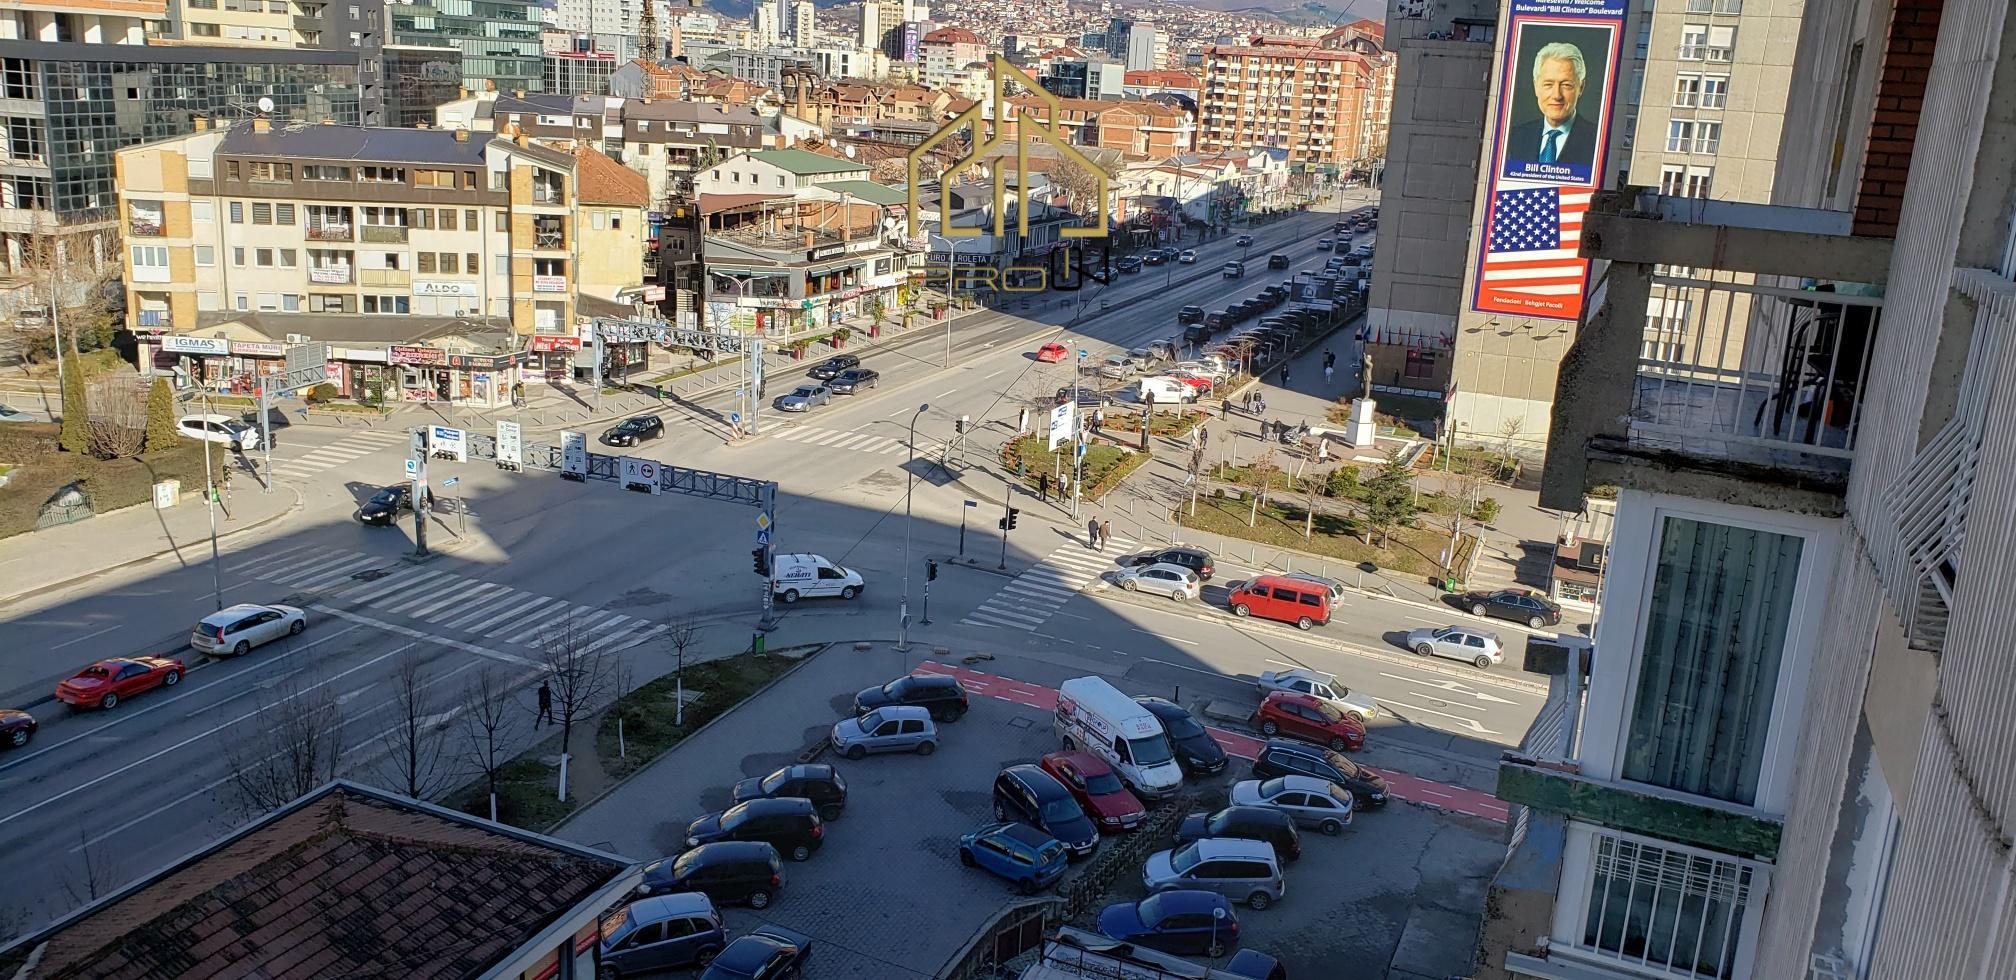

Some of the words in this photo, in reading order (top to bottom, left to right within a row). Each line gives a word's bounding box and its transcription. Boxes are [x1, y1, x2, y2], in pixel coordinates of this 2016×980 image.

[1515, 4, 1547, 12] Bulevardi
[1525, 164, 1538, 172] Bill
[1540, 165, 1570, 174] Clinton
[957, 254, 987, 263] ROLETA
[425, 284, 461, 293] ALDO
[175, 338, 215, 349] IGMAS
